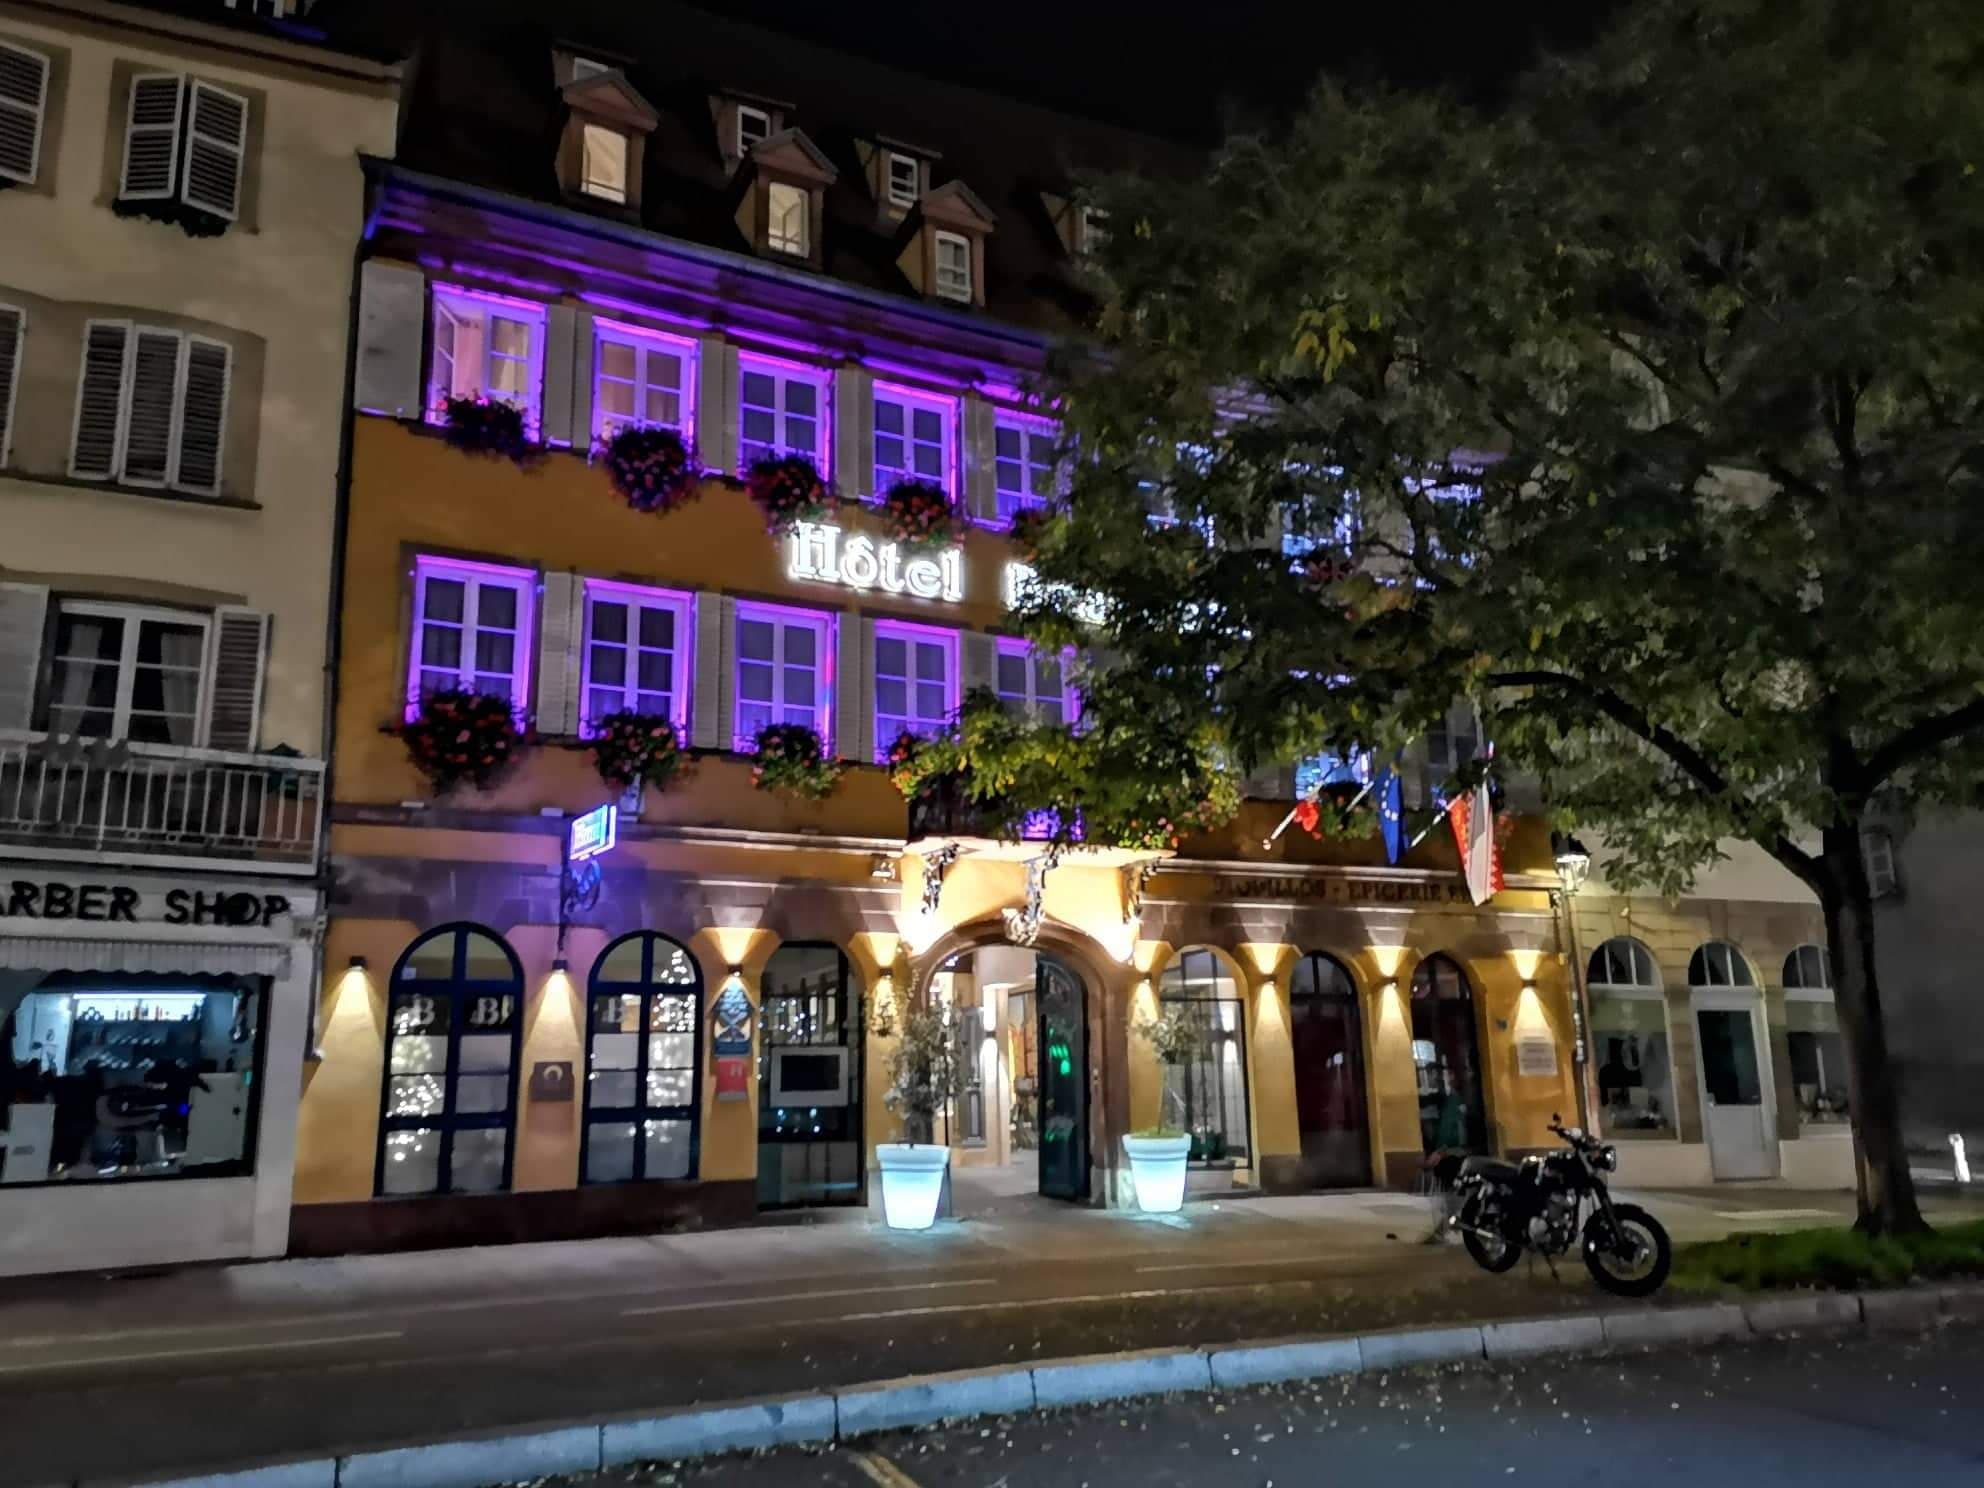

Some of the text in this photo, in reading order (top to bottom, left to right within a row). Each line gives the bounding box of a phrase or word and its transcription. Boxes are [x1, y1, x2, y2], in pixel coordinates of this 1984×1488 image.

[789, 520, 963, 602] Hôtel
[0, 880, 290, 927] RBER SHOP
